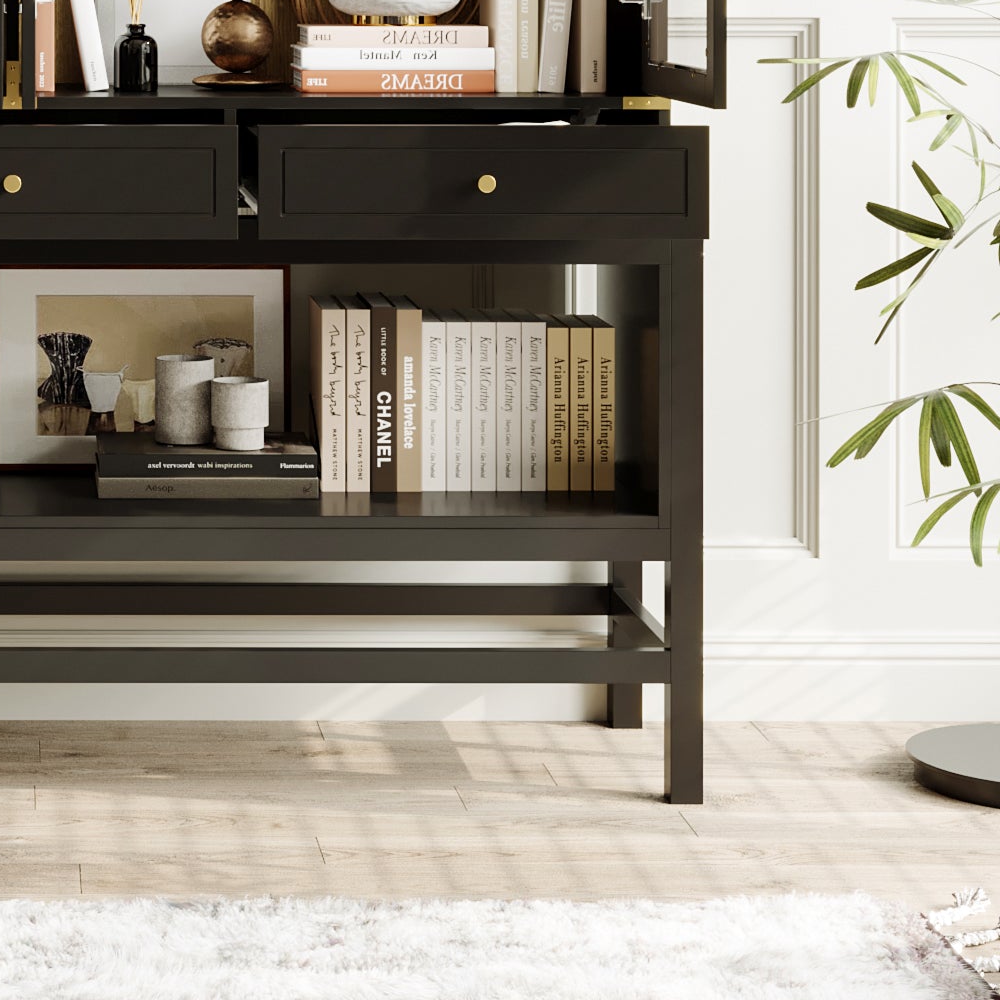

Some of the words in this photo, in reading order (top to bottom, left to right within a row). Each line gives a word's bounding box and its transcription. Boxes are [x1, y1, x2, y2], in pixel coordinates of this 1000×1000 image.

[328, 324, 340, 347] The
[353, 324, 365, 347] The
[429, 336, 442, 362] Karen
[454, 336, 467, 362] Karen
[479, 336, 492, 362] Karen
[504, 336, 517, 362] Karen
[530, 336, 543, 362] Karen
[328, 351, 343, 375] body
[353, 351, 368, 375] body
[403, 355, 416, 401] amanda
[554, 357, 566, 399] Arianna
[577, 357, 589, 399] Arianna
[600, 357, 612, 399] Arianna
[322, 379, 342, 417] beyond
[347, 379, 367, 417] beyond
[424, 364, 442, 413] McCartney
[450, 364, 467, 413] McCartney
[475, 364, 492, 413] McCartney
[500, 364, 517, 413] McCartney
[525, 364, 543, 413] McCartney
[376, 391, 392, 468] CHANEL
[403, 402, 416, 449] lovelace
[550, 403, 566, 463] Huffington
[574, 403, 589, 463] Huffington
[597, 403, 612, 463] Huffington
[147, 461, 162, 469] axel
[162, 461, 195, 469] vervoordt
[197, 461, 213, 469] wabi
[214, 461, 253, 470] inspirations
